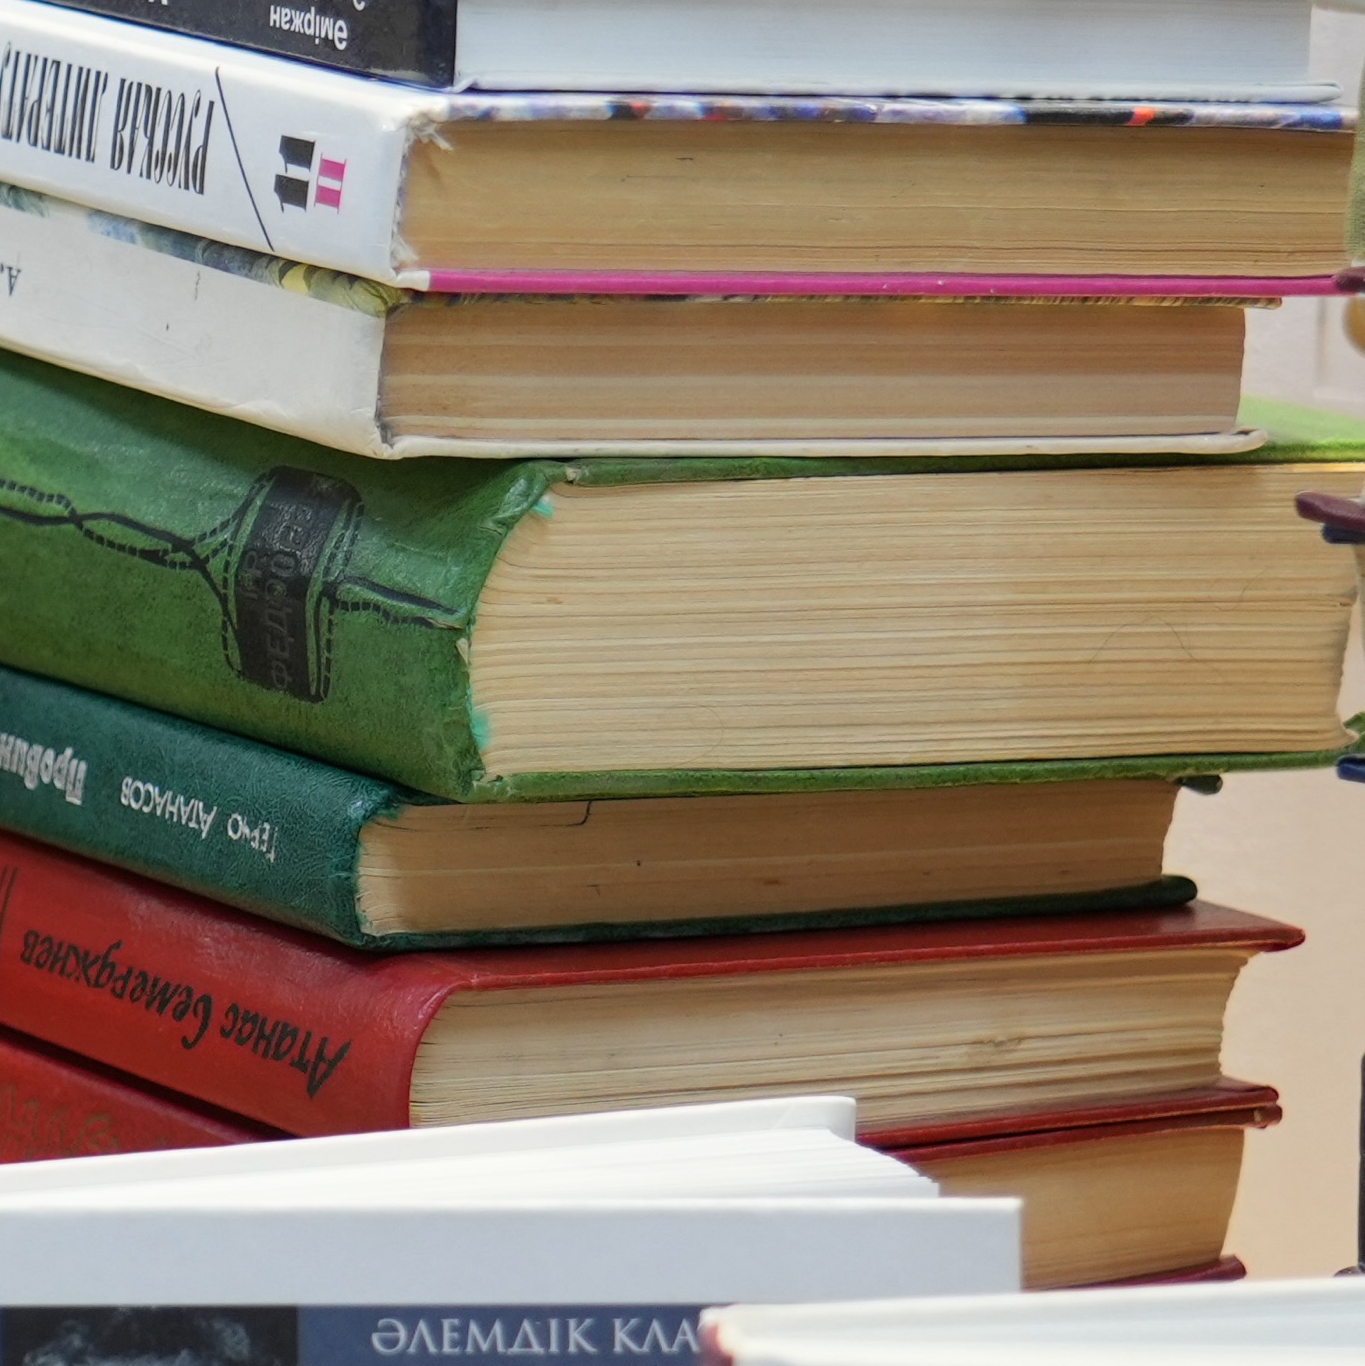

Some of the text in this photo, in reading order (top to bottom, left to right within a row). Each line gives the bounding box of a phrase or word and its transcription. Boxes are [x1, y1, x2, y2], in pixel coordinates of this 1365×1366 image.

[269, 4, 349, 50] Әміржан
[109, 78, 216, 197] РУССКАЯ
[219, 999, 352, 1099] Атанас
[370, 1317, 701, 1357] ӘЛЕМДІК КЛА
